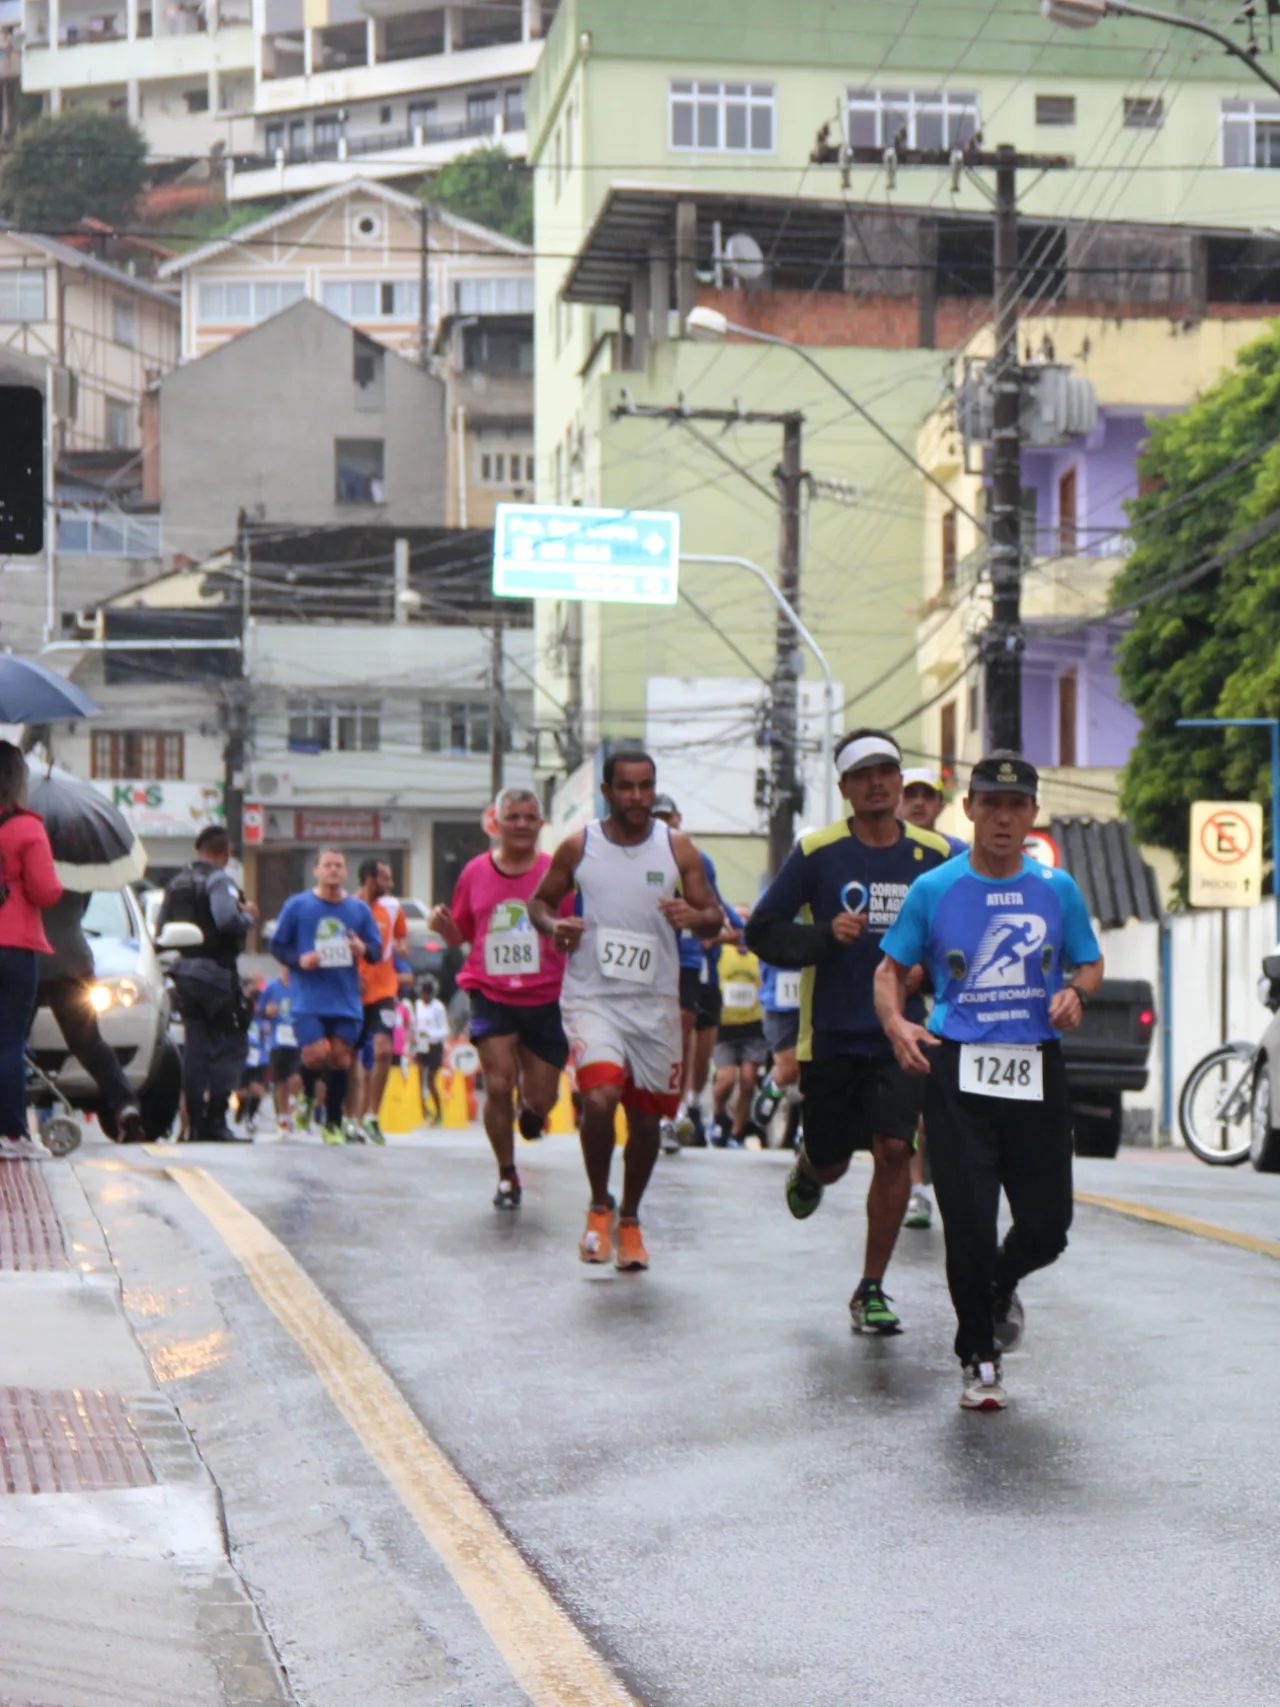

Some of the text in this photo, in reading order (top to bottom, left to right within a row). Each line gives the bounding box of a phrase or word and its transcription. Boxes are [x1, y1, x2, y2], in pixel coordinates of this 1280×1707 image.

[869, 882, 909, 897] CORRID
[986, 891, 1024, 906] ATLETA
[493, 943, 533, 965] 1288
[601, 941, 651, 971] 5270
[973, 1055, 1032, 1087] 1248
